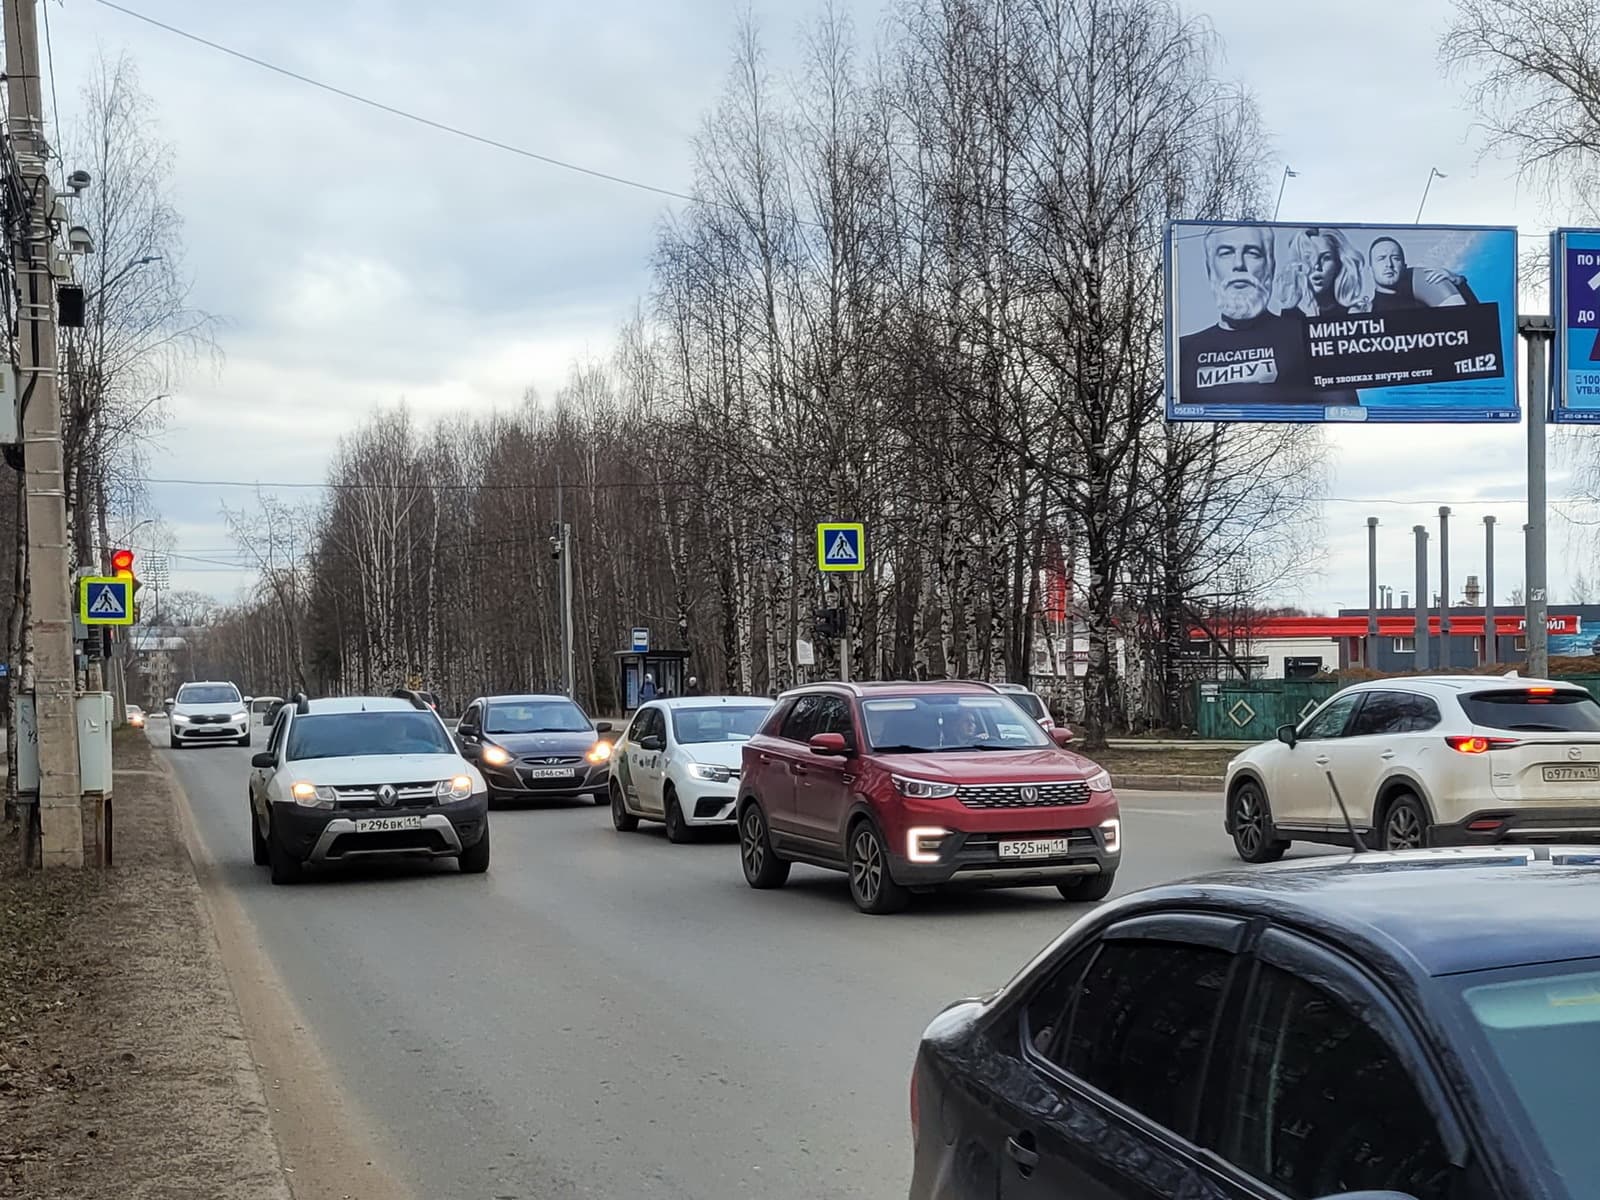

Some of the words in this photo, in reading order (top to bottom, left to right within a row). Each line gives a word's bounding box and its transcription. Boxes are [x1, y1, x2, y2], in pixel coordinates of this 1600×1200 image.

[1577, 254, 1593, 265] ПО
[1577, 310, 1595, 323] ДО
[1309, 319, 1385, 339] МИНУТЫ
[1311, 342, 1334, 357] НЕ
[1338, 330, 1469, 355] РАСХОДУЮТСЯ
[1197, 347, 1274, 364] СПАСАТЕЛИ
[1454, 354, 1497, 374] TELE2
[1199, 360, 1274, 386] МИНУТ
[1314, 376, 1334, 387] При
[1336, 373, 1373, 383] звонках
[1375, 371, 1410, 382] внутри
[1411, 368, 1433, 378] сети
